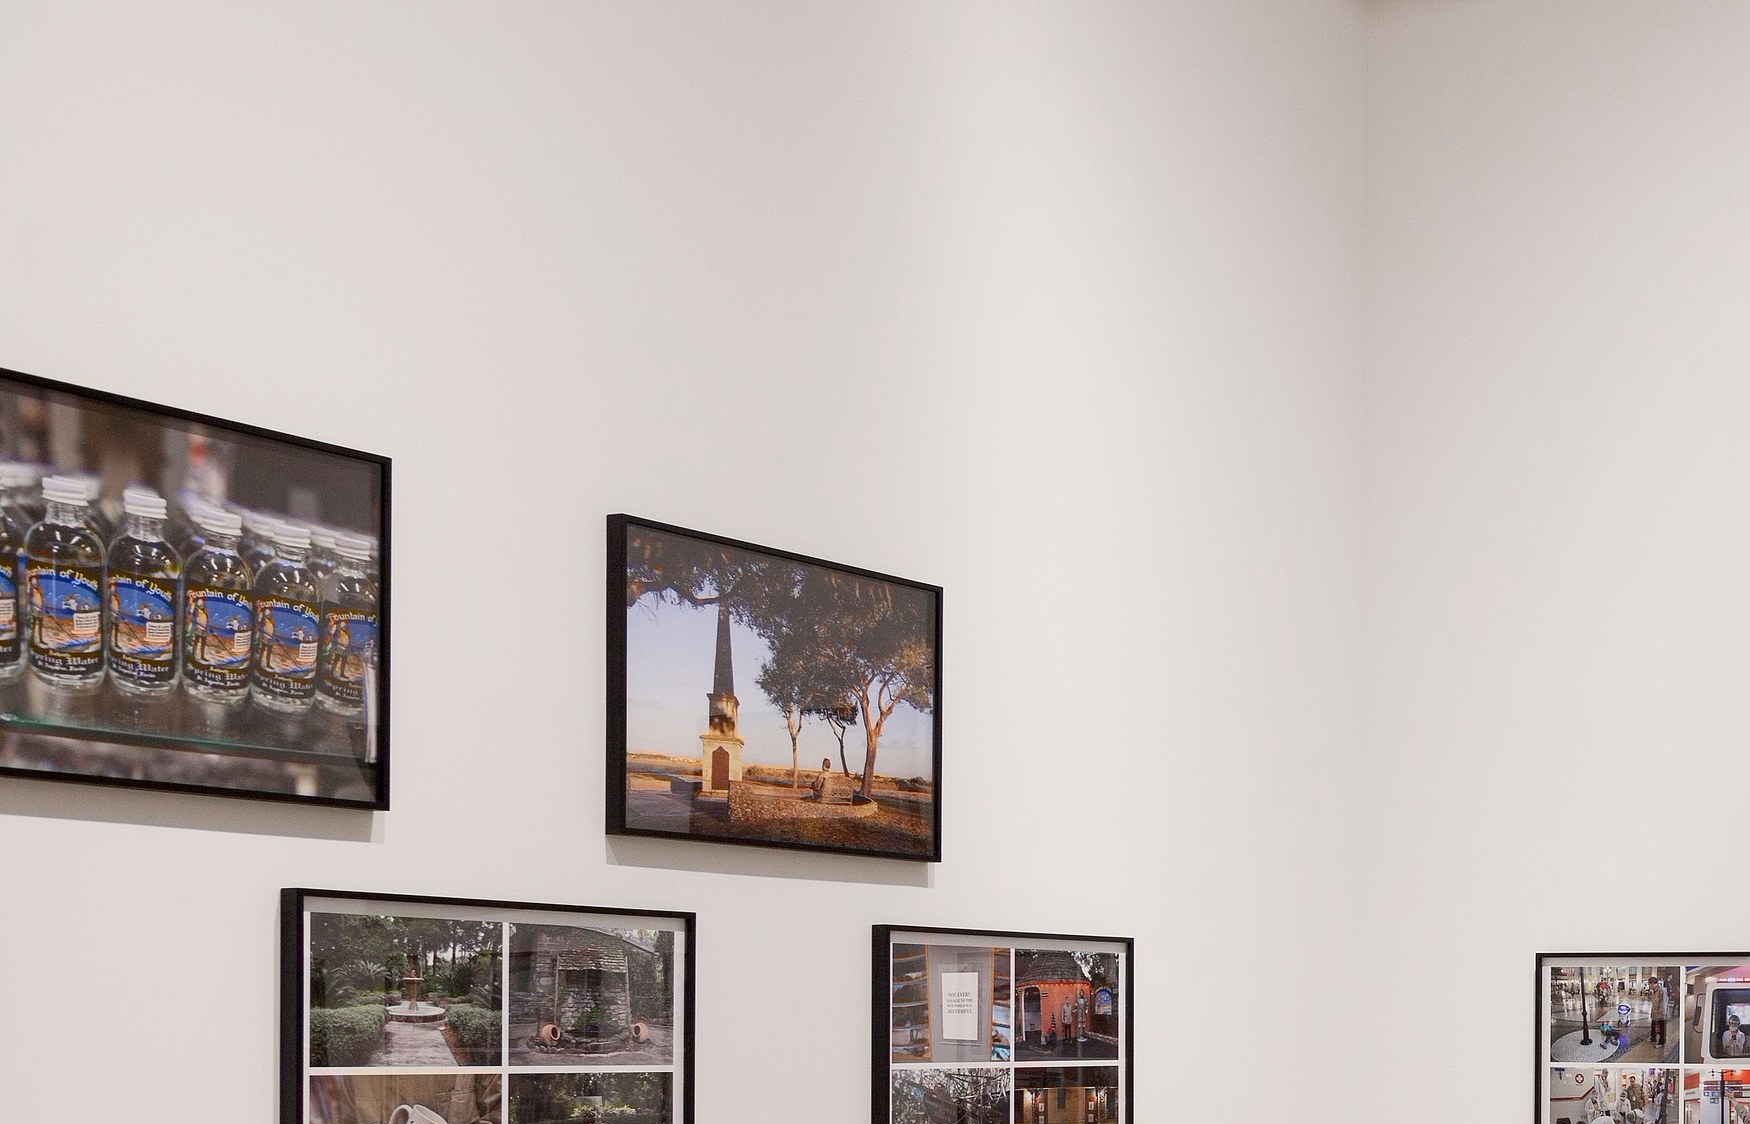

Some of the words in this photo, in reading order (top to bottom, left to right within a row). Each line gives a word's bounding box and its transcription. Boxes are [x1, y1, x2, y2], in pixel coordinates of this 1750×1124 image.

[60, 570, 74, 578] of
[71, 572, 98, 591] Youth
[135, 579, 149, 588] of
[146, 583, 172, 603] Youth
[226, 592, 240, 601] of
[236, 595, 253, 609] You
[293, 604, 305, 612] of
